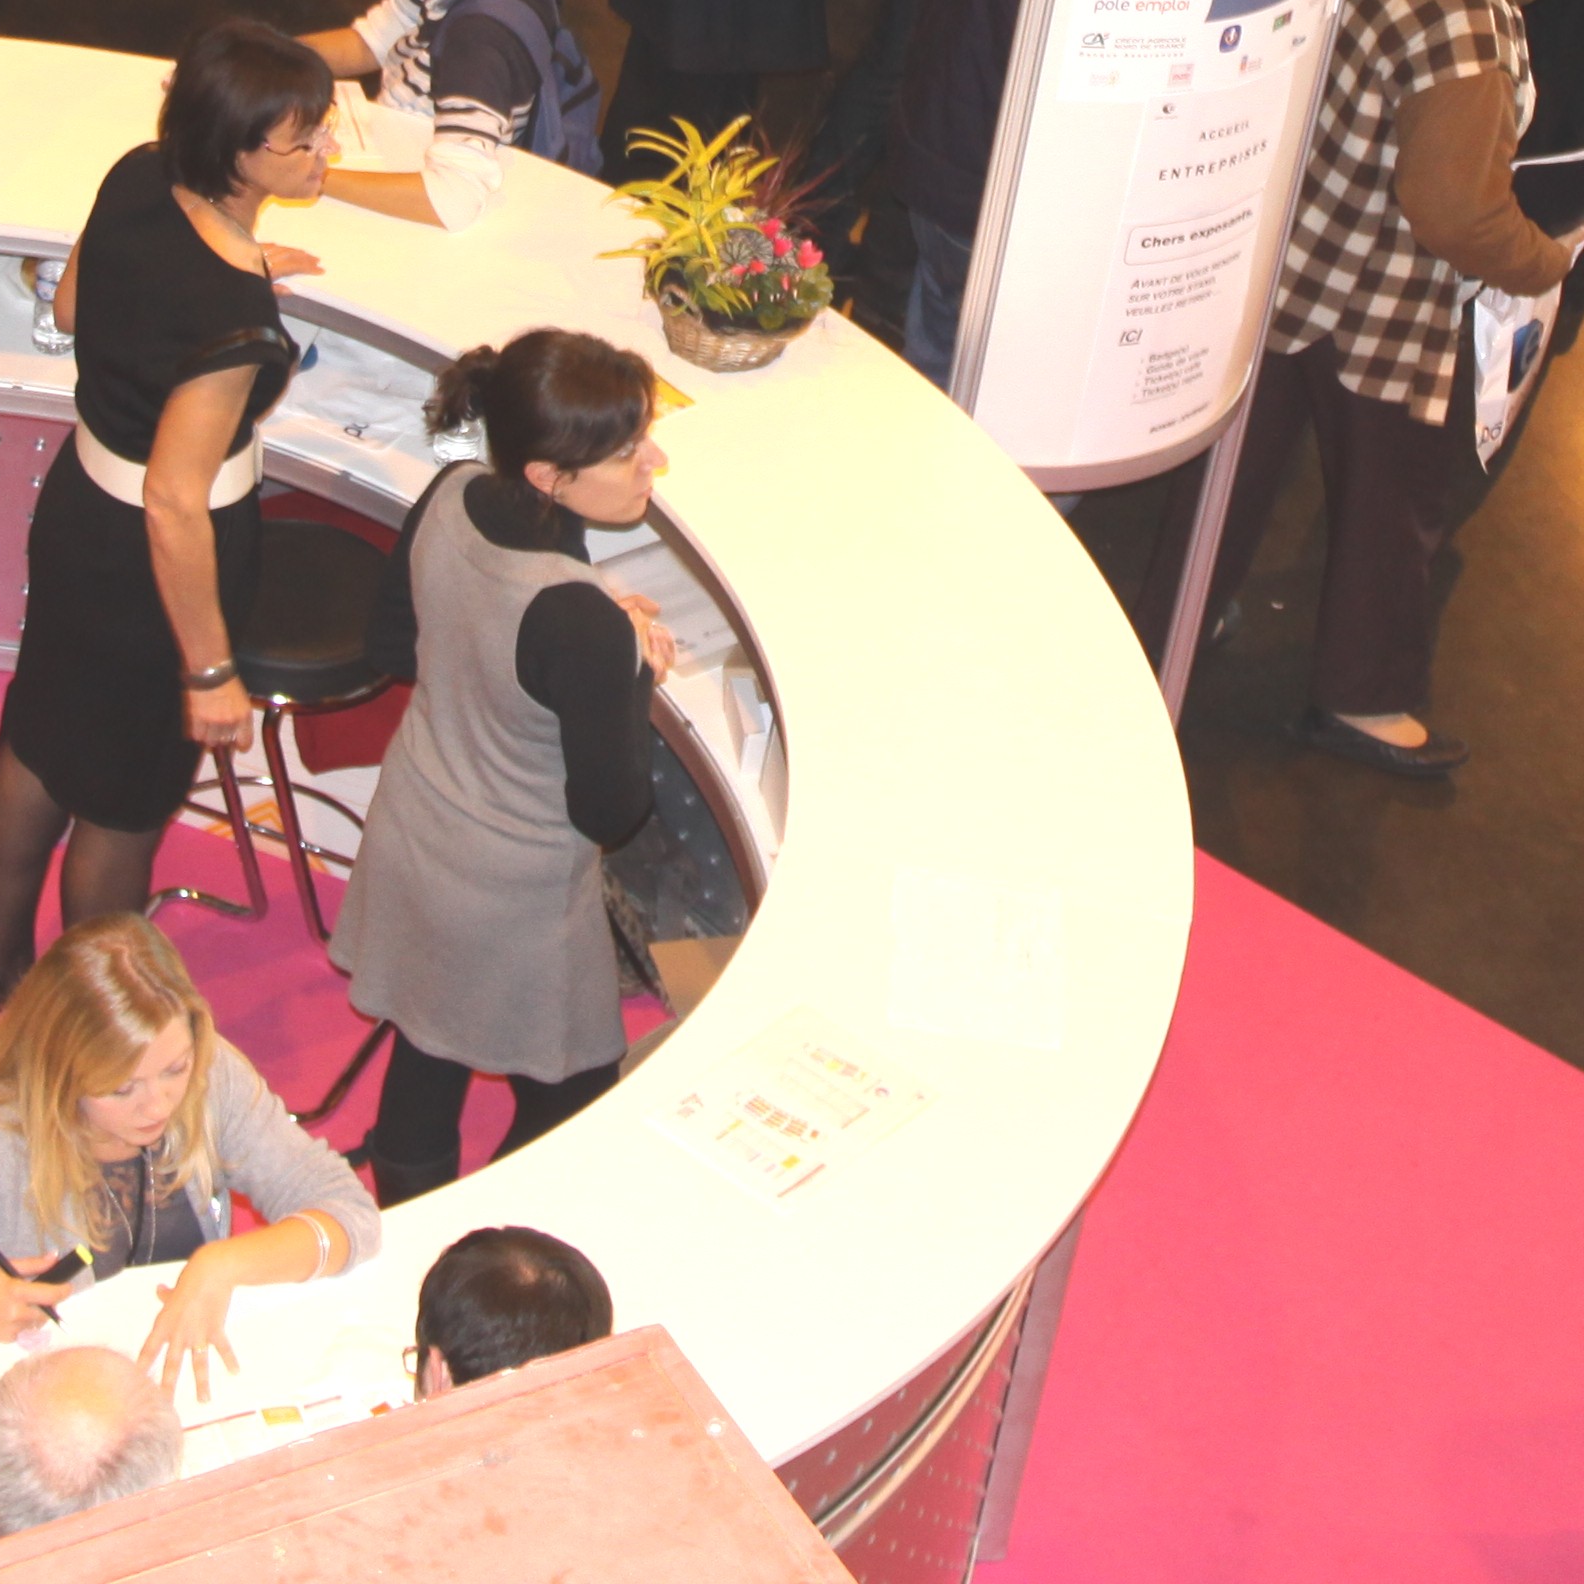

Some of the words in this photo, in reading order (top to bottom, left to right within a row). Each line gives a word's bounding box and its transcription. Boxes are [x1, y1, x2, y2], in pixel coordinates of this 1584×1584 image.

[1199, 120, 1250, 142] ACCUEIL
[1158, 139, 1268, 181] ENTREPRISES
[1141, 234, 1185, 250] Chers
[1131, 277, 1168, 290] AVANT
[1119, 329, 1144, 346] ICI
